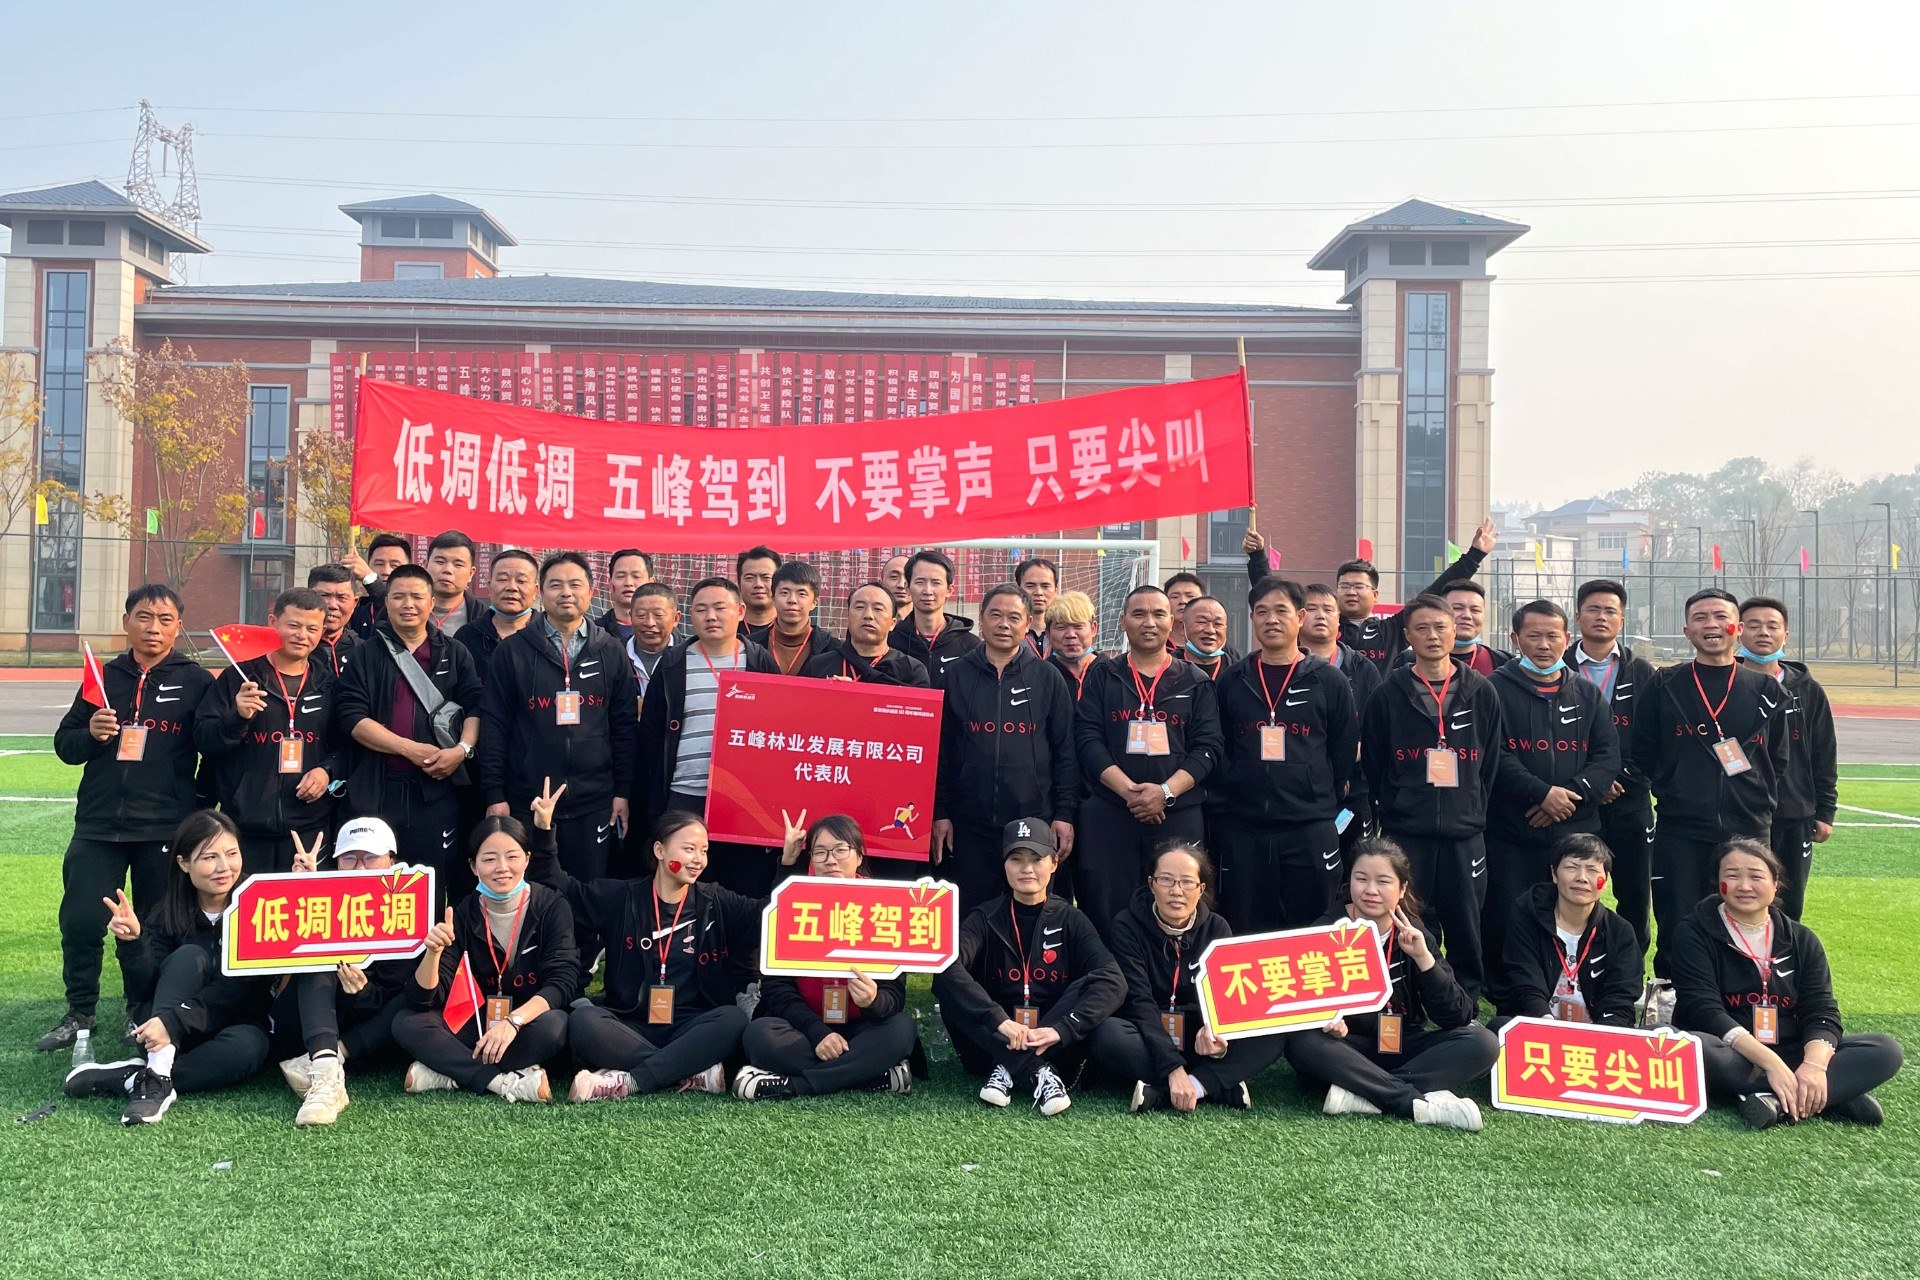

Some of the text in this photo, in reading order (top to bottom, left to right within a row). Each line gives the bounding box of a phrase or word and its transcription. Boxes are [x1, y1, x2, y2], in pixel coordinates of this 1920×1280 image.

[333, 366, 344, 399] 团结协作
[437, 366, 448, 390] 低调低
[459, 366, 470, 396] 五峰
[480, 367, 491, 400] 齐心协力
[501, 368, 512, 404] 自然资
[521, 366, 532, 406] 同心协力
[543, 367, 554, 400] 积极进取
[650, 368, 661, 422] 健康第一 快乐
[697, 367, 708, 401] 赛出风格
[717, 365, 727, 399] 三农健将
[739, 368, 749, 402] 意气风发
[760, 366, 771, 423] 共创卫生城
[781, 366, 792, 419] 快乐疾控队
[802, 368, 813, 402] 发型到位
[844, 369, 855, 403] 对党忠诚
[864, 369, 875, 405] 市场监管
[887, 369, 899, 403] 积极进取
[906, 369, 918, 417] 民生民
[928, 370, 940, 416] 团结友爱
[972, 373, 982, 411] 自然资
[995, 372, 1007, 406] 团结拼搏
[671, 368, 682, 425] 牢记使命 艰苦
[823, 369, 835, 424] 敢闯敢拼
[393, 409, 1210, 527] 低调低调 五峰驾到 不要掌声 只要尖叫
[964, 721, 1037, 736] WOOSH
[727, 729, 924, 764] 五峰林业发展有限公司
[794, 762, 851, 785] 代表队
[1018, 822, 1031, 838] LA
[251, 892, 417, 943] 低调低调
[788, 901, 942, 951] 五峰驾到
[1220, 945, 1372, 1006] 不要掌声
[1519, 1041, 1686, 1102] 只要尖叫
